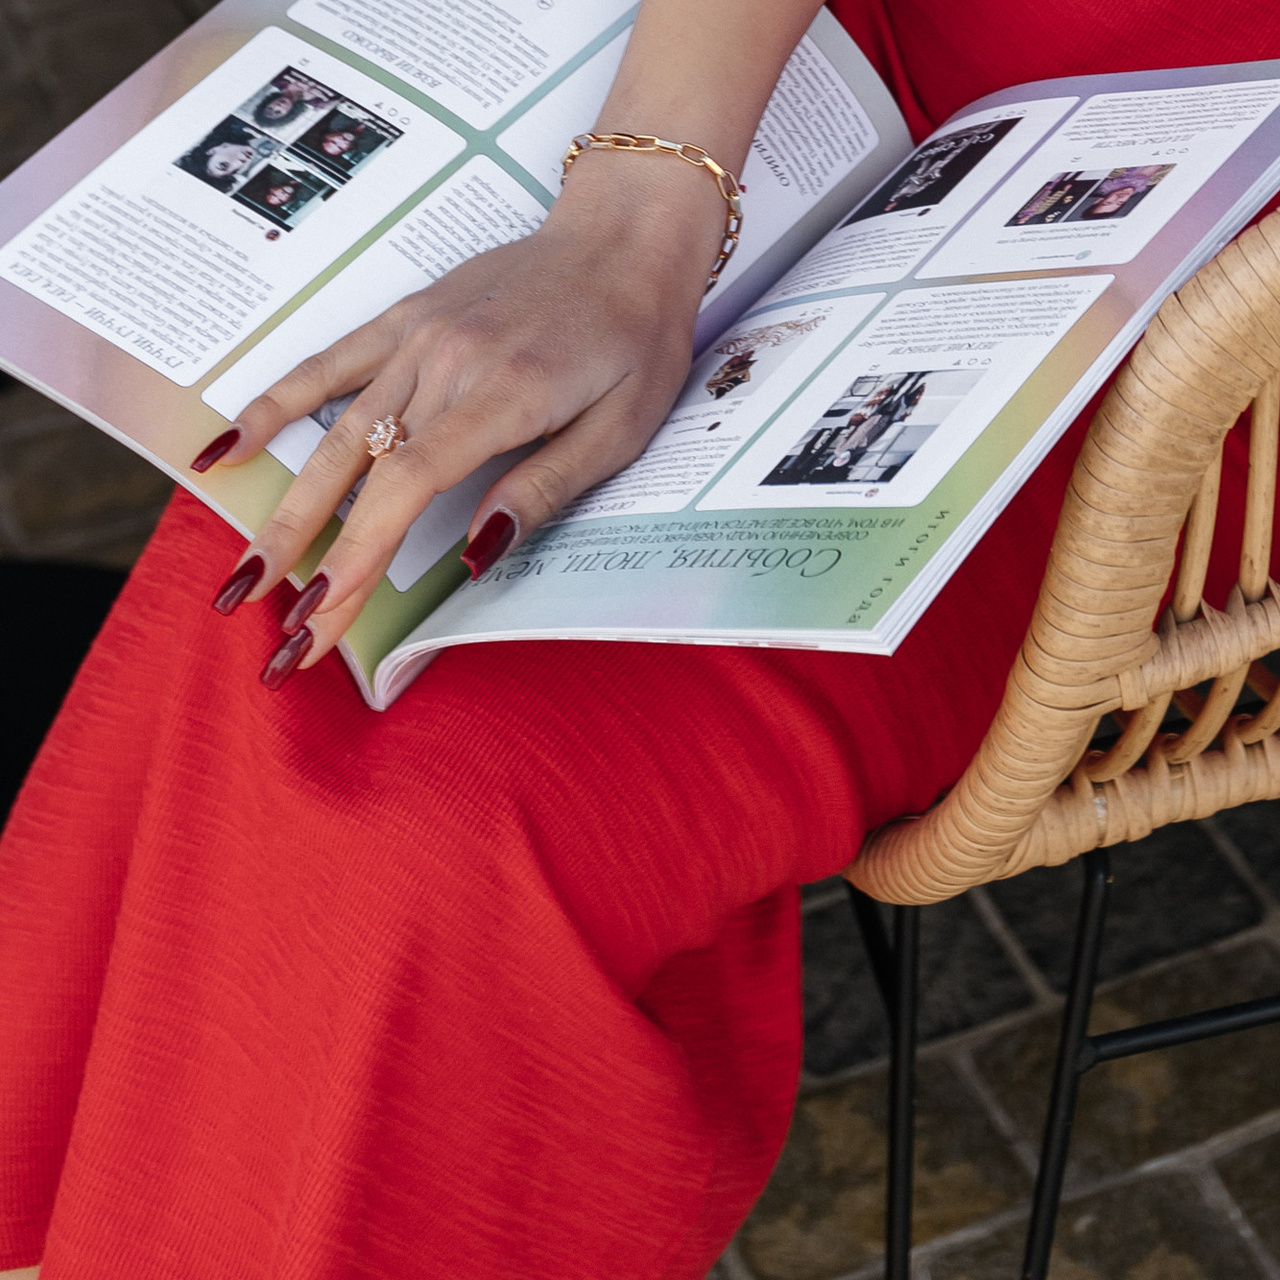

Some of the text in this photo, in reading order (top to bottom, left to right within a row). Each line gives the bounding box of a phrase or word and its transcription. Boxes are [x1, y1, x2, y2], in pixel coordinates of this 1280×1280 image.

[726, 531, 759, 541] МОДУ
[763, 531, 869, 541] СОВРЕМЕННУЮ
[561, 549, 663, 574] люди,
[666, 544, 842, 578] События,
